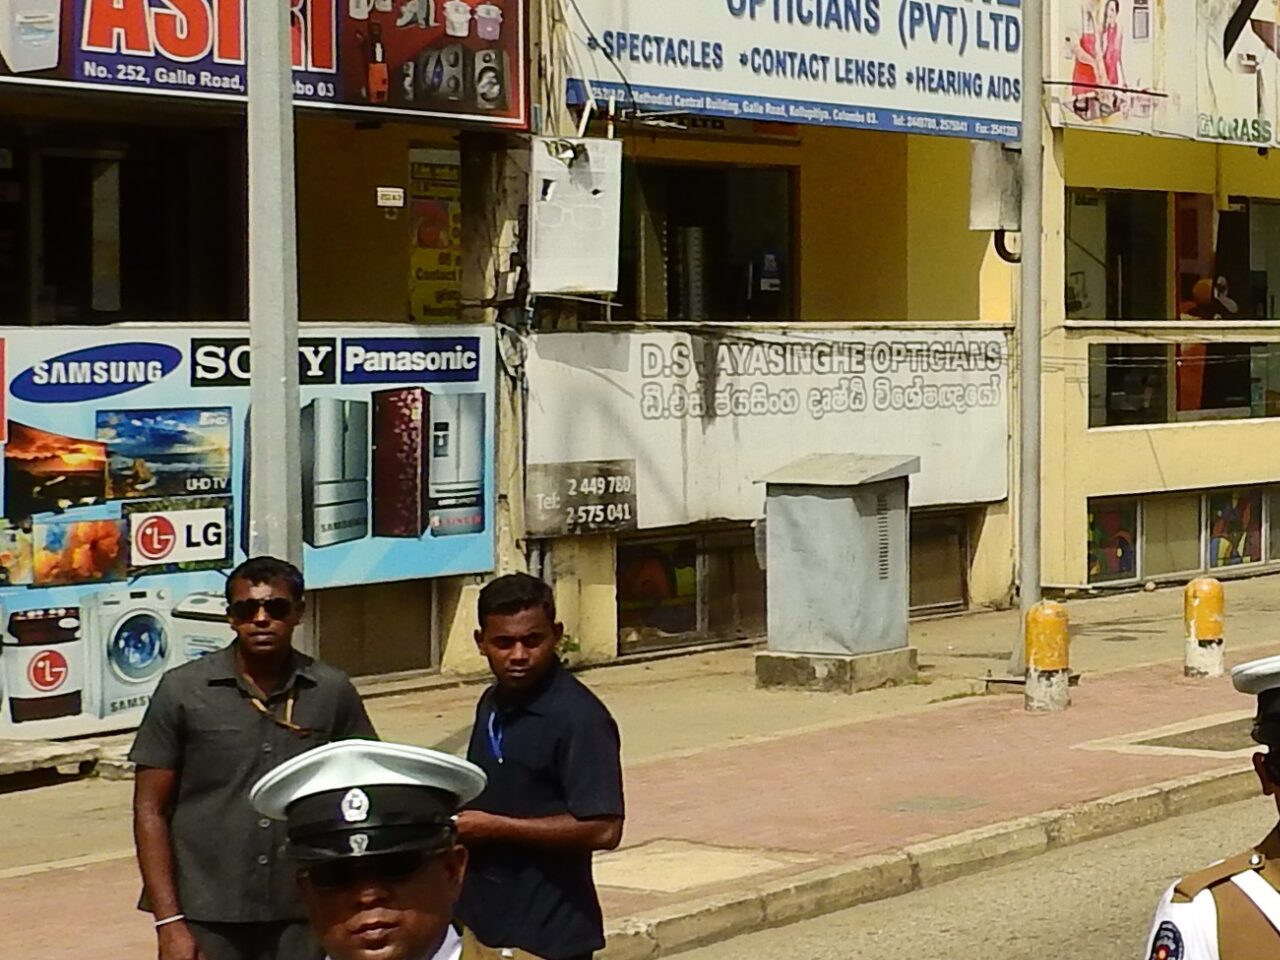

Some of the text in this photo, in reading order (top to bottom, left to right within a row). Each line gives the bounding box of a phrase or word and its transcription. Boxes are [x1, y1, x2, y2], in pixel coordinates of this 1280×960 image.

[898, 1, 968, 55] (PVT)
[976, 10, 1021, 53] LTD
[603, 31, 723, 69] SPECTACLES
[84, 61, 112, 79] No.
[155, 67, 196, 86] Galle
[200, 71, 245, 92] Road,
[751, 47, 897, 90] CONTACT LENSES
[915, 66, 1021, 102] HEARING AIDS
[317, 81, 334, 97] 03
[674, 94, 703, 109] Central
[742, 100, 763, 114] Galle
[32, 360, 164, 384] SAMSUNG
[195, 345, 333, 380] SOY
[344, 345, 477, 374] Panasonic
[872, 341, 1001, 373] OPTICIANS
[186, 522, 222, 548] LG
[111, 696, 147, 713] SAMS
